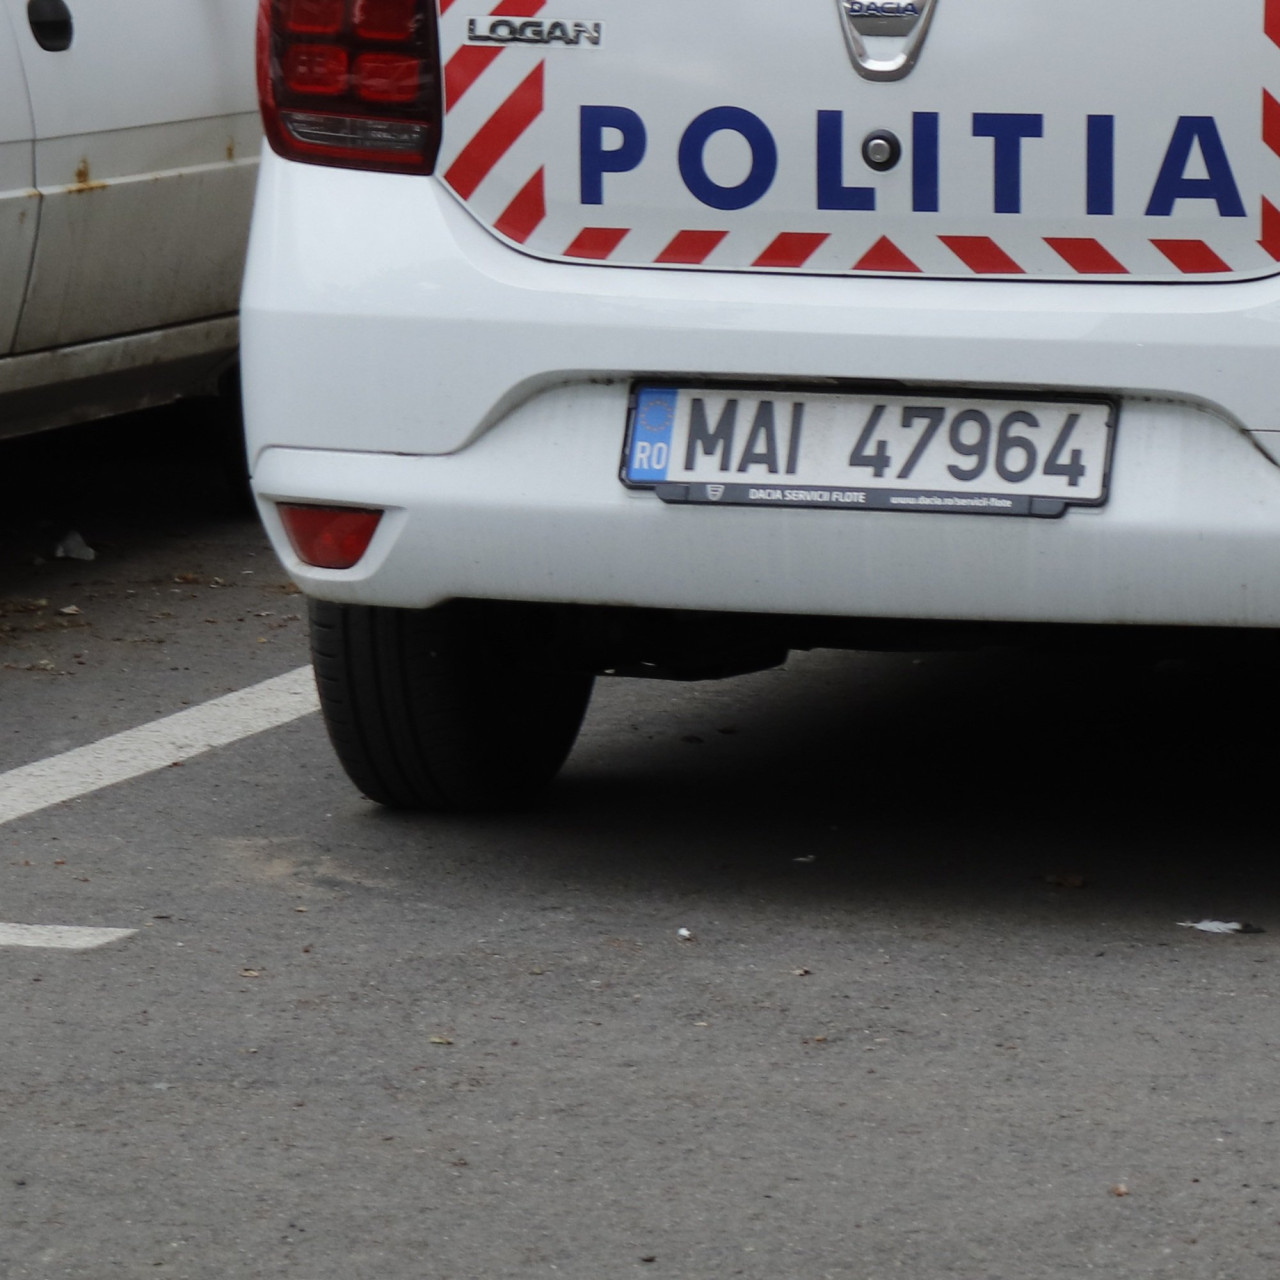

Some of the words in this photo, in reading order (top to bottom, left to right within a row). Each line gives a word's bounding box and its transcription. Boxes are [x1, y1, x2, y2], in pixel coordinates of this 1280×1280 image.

[849, 1, 919, 16] DACIA
[468, 18, 601, 45] LOGAN
[580, 105, 1247, 217] POLITIA
[633, 441, 668, 470] RO
[683, 398, 804, 475] MAI
[848, 404, 1086, 487] 47964
[748, 488, 783, 500] DACIA
[784, 490, 831, 502] SERVICII
[831, 491, 867, 503] FLOTE
